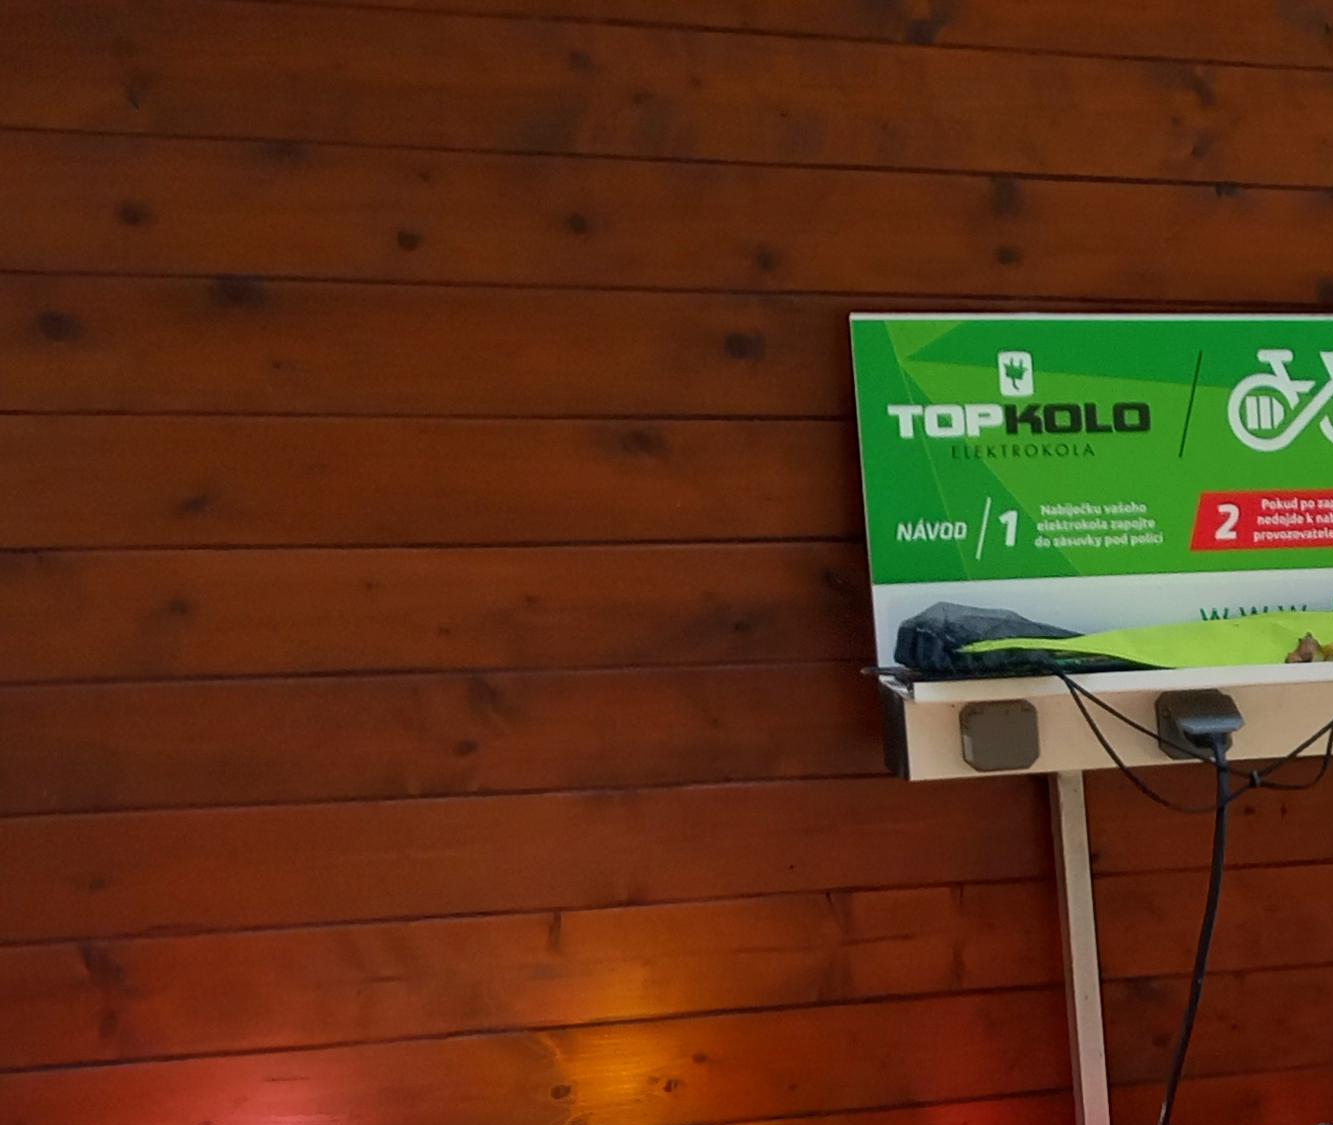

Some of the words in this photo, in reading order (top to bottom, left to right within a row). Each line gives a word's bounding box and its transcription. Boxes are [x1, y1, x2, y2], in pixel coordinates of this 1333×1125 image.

[887, 402, 1151, 439] TOPKOLO
[951, 443, 1096, 459] ELEKTROKOLA
[1261, 497, 1298, 510] Pokud
[1300, 499, 1315, 511] po
[896, 517, 968, 541] NÁVOD
[998, 510, 1018, 547] 1
[1214, 503, 1240, 540] 2
[1256, 512, 1304, 527] nedojde
[1305, 512, 1314, 524] k
[1034, 535, 1051, 548] do
[1104, 533, 1128, 547] pod
